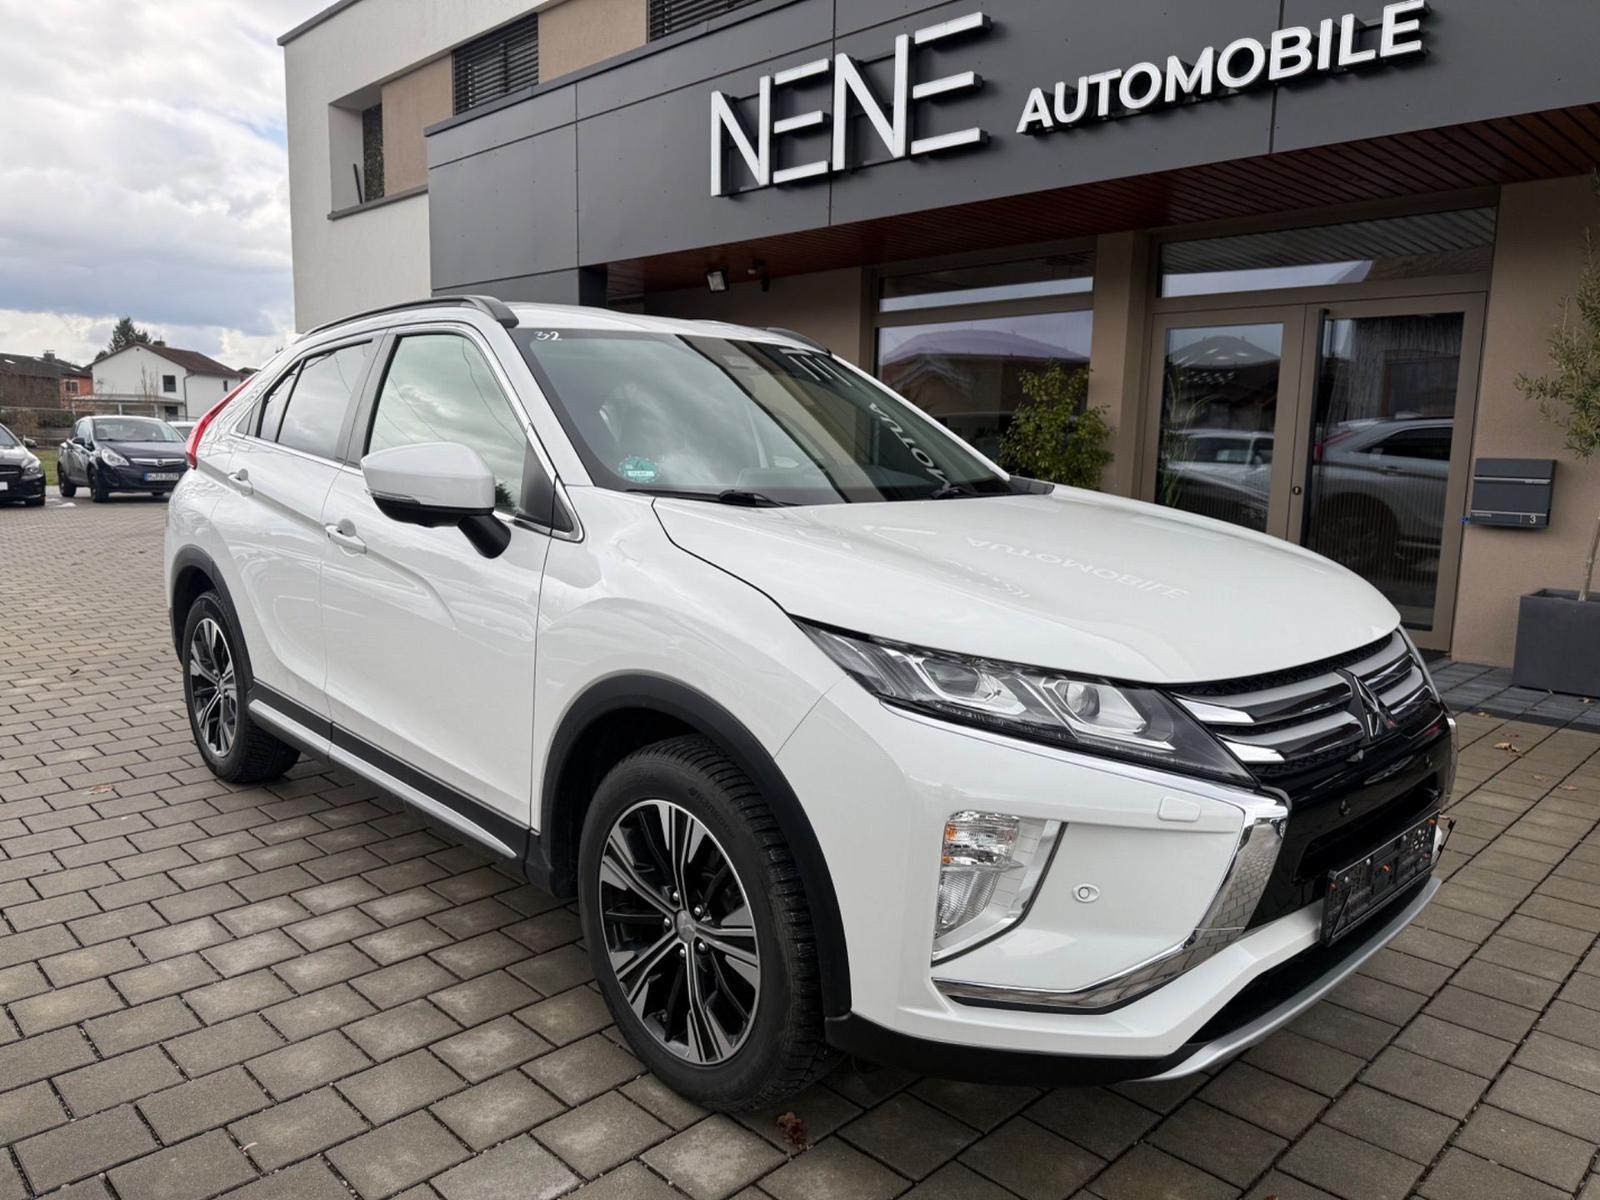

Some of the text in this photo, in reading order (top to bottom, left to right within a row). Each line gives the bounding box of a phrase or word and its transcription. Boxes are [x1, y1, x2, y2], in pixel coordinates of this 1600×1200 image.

[710, 0, 1424, 197] NENE AUTOMOBILE
[1529, 514, 1537, 524] 3
